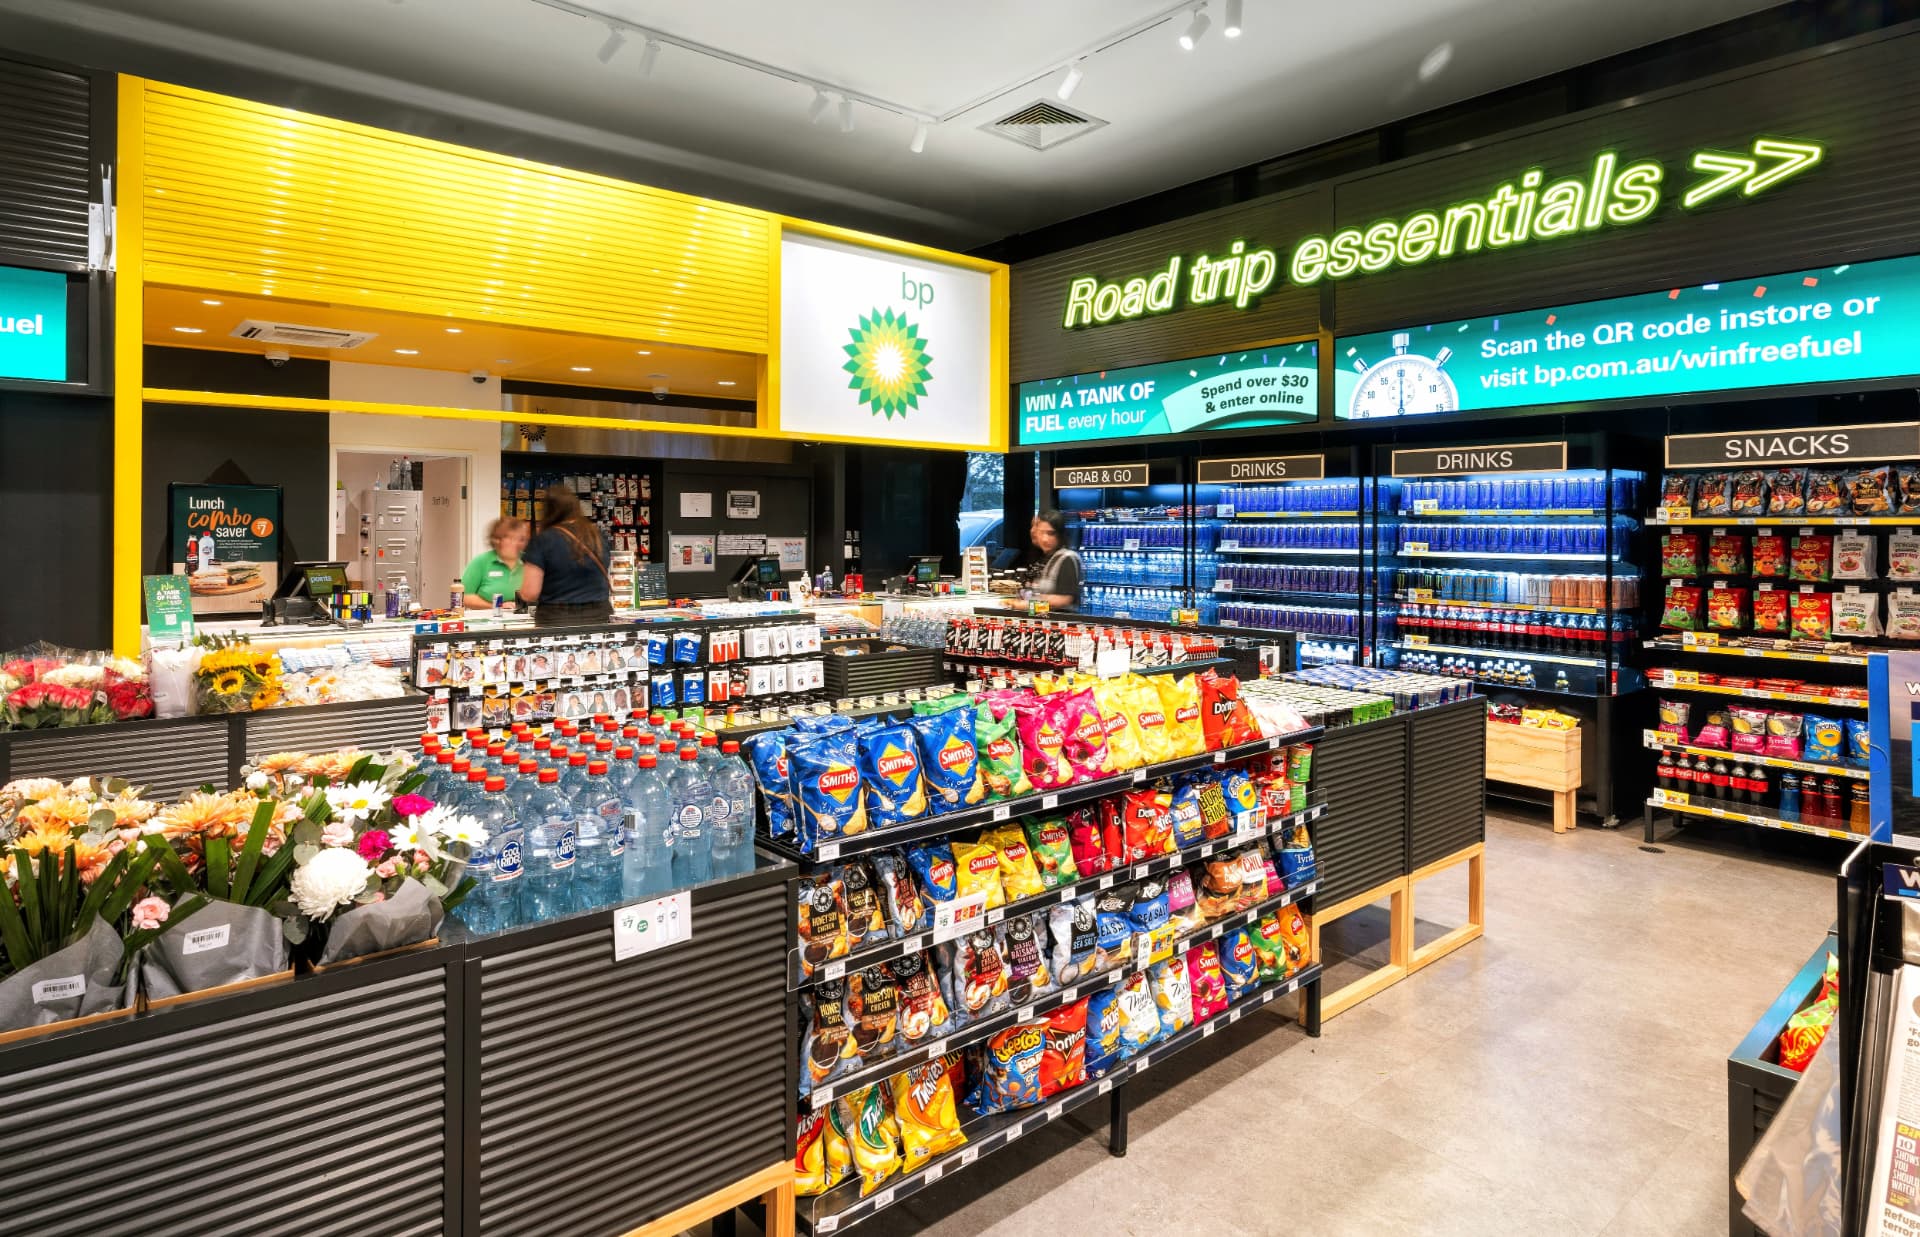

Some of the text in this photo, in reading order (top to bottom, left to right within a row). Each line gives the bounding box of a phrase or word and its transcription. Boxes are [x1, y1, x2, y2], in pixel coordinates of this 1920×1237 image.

[1064, 151, 1663, 328] Road trip essentials
[902, 272, 934, 310] bp
[1480, 293, 1880, 358] Scan the QR code instore or
[1480, 330, 1862, 389] visit bp.com.au/winfreefuel
[1201, 374, 1309, 398] Spend over $30
[1367, 391, 1375, 400] 50
[1429, 385, 1437, 393] 10
[1025, 381, 1155, 412] WIN A TANK OF
[1205, 390, 1304, 413] & enter online
[1025, 406, 1146, 433] FUEL every hour
[1724, 433, 1850, 459] SNACKS
[1231, 461, 1286, 477] DRINKS
[1436, 450, 1513, 470] DRINKS
[1068, 469, 1132, 484] GRAB & GO
[190, 497, 224, 509] Lunch
[187, 508, 252, 530] combo
[216, 526, 247, 538] saver
[879, 753, 916, 773] SMITH'S
[941, 743, 976, 763] SMITH'S
[822, 769, 858, 790] SMITH'S
[1046, 1027, 1085, 1052] Doritos
[912, 1059, 943, 1111] Twisties
[1899, 1137, 1913, 1151] 10
[1894, 1159, 1908, 1173] YOU
[1895, 1149, 1919, 1165] SHOWS
[1893, 1168, 1920, 1187] SHOULD
[1891, 1180, 1916, 1197] WATCH
[1883, 1219, 1914, 1237] terror
